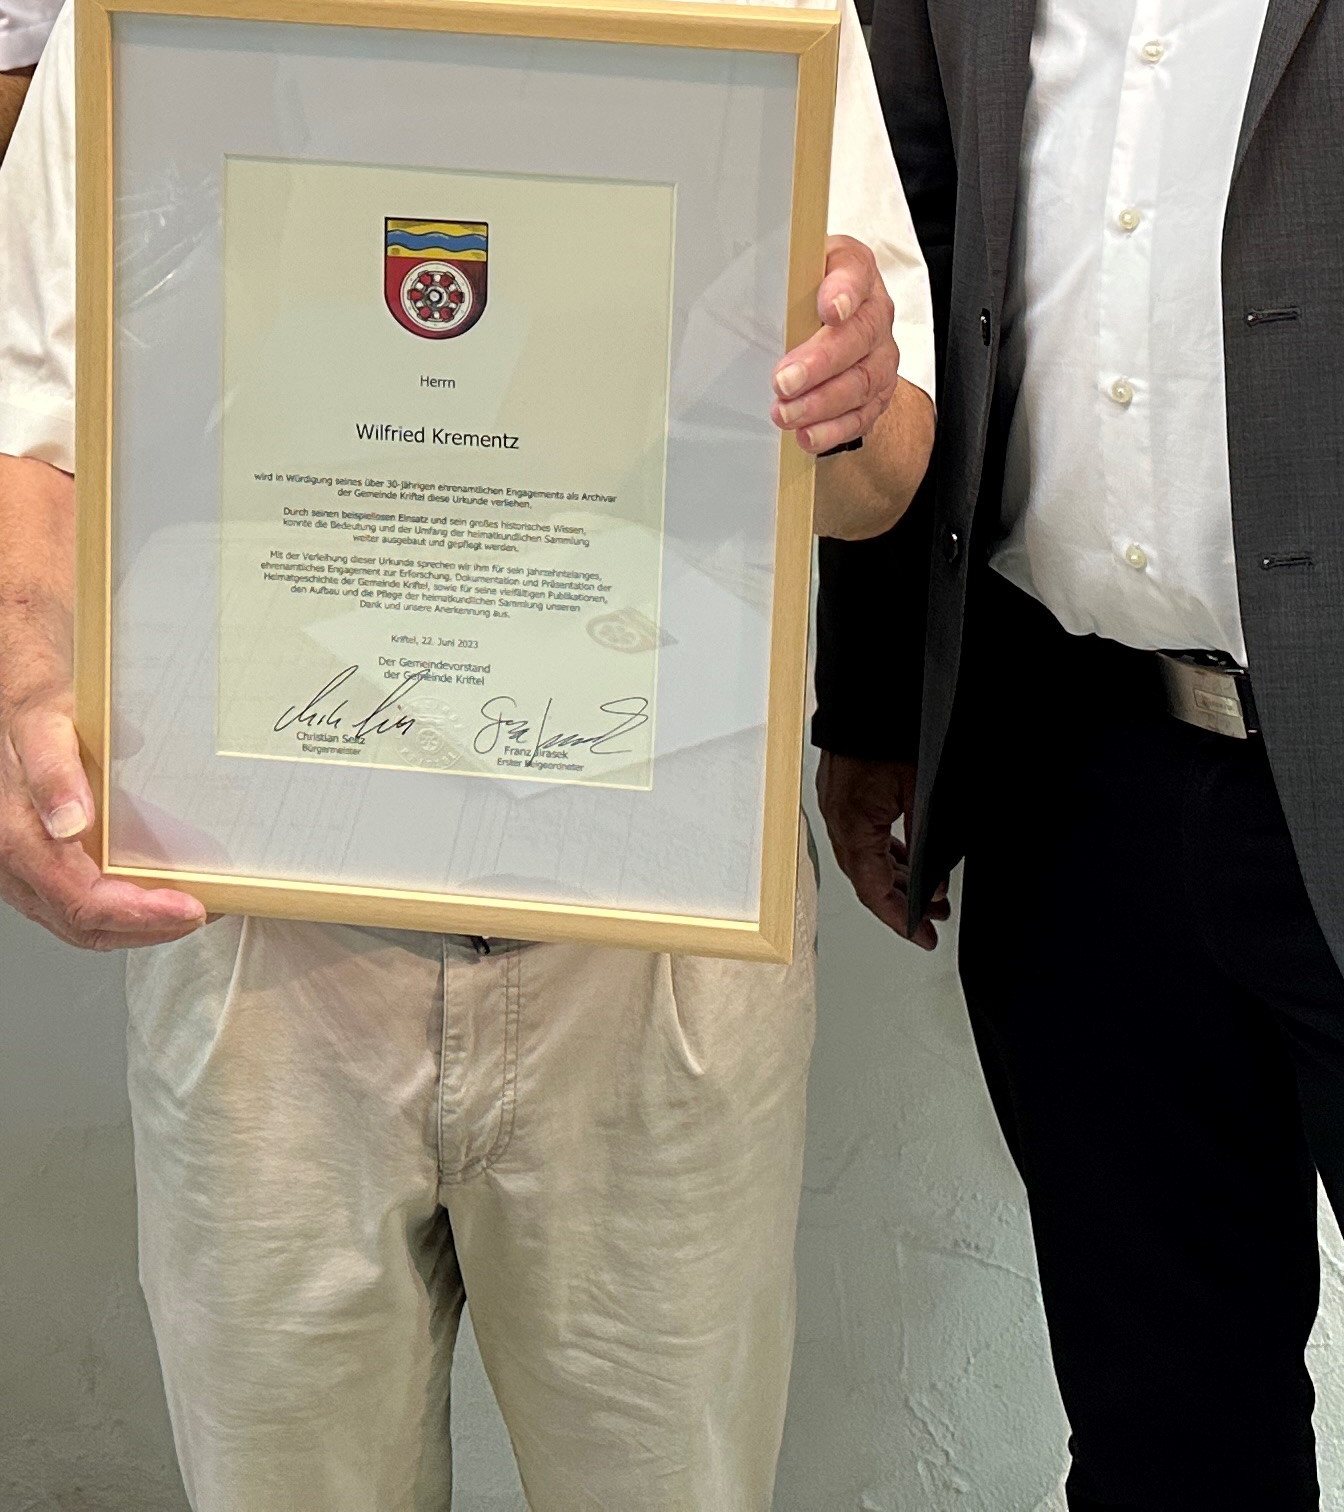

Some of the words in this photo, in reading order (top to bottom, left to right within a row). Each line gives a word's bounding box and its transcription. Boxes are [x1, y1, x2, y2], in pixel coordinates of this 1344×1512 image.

[420, 375, 456, 388] Herrn
[356, 423, 425, 443] Wilfried
[432, 428, 519, 449] Krementz
[379, 656, 396, 666] Der
[399, 658, 491, 673] Gemeindevorstand
[384, 670, 400, 679] der
[404, 671, 452, 683] Gemeinde
[456, 675, 484, 686] Kriftel
[296, 732, 339, 743] Christian
[342, 735, 365, 744] Seitz
[504, 746, 531, 756] Franz
